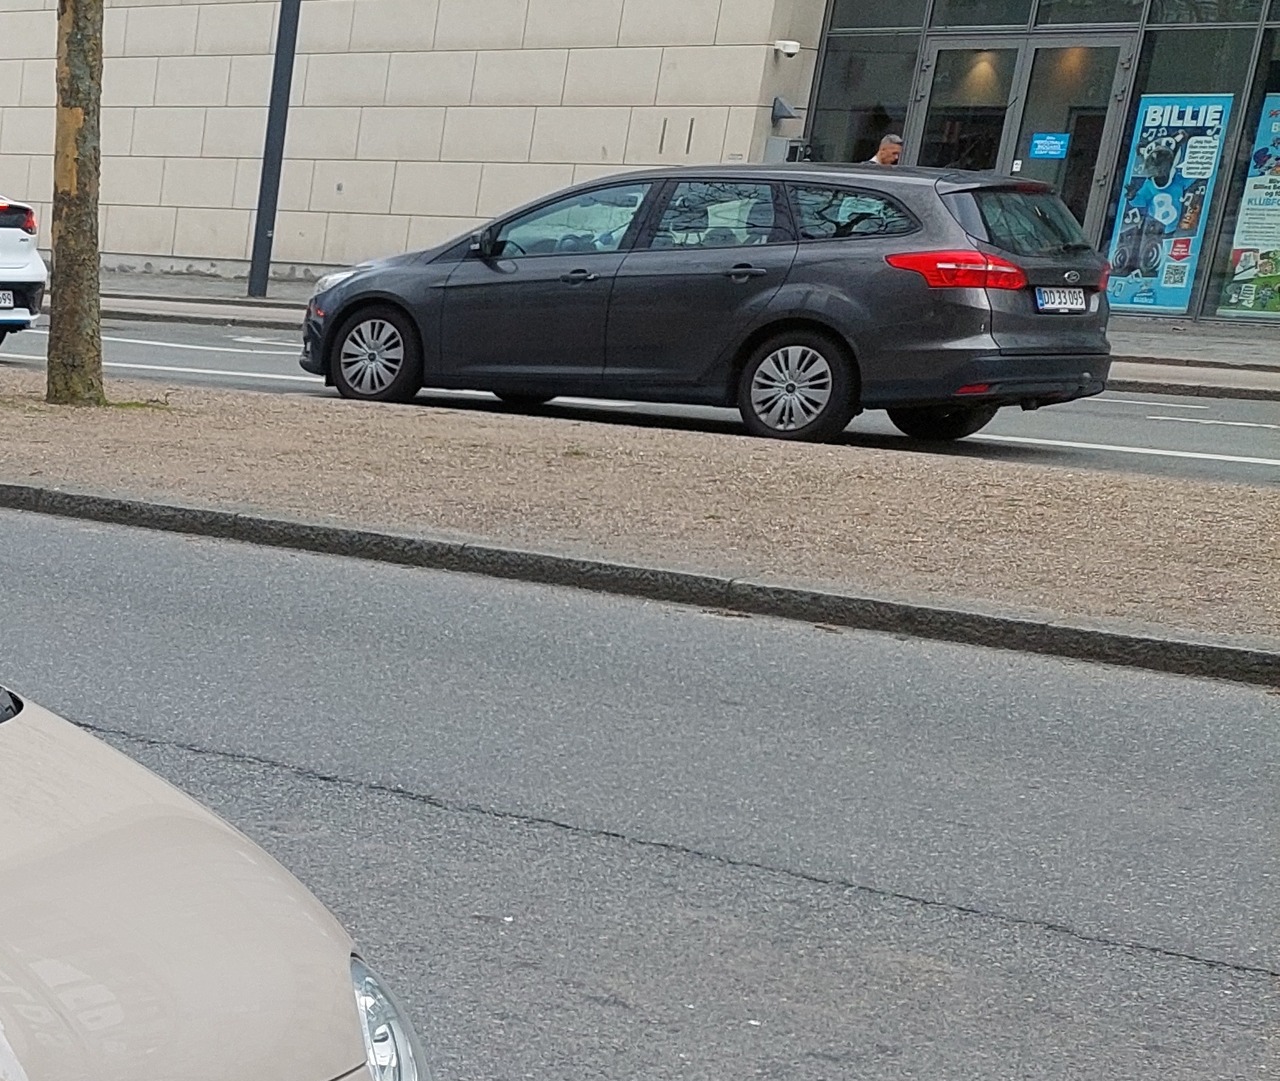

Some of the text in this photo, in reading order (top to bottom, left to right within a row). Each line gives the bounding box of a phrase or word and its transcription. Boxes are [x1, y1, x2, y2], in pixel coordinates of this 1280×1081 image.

[1145, 105, 1222, 126] BILLIE
[1043, 290, 1083, 305] DD 33 095
